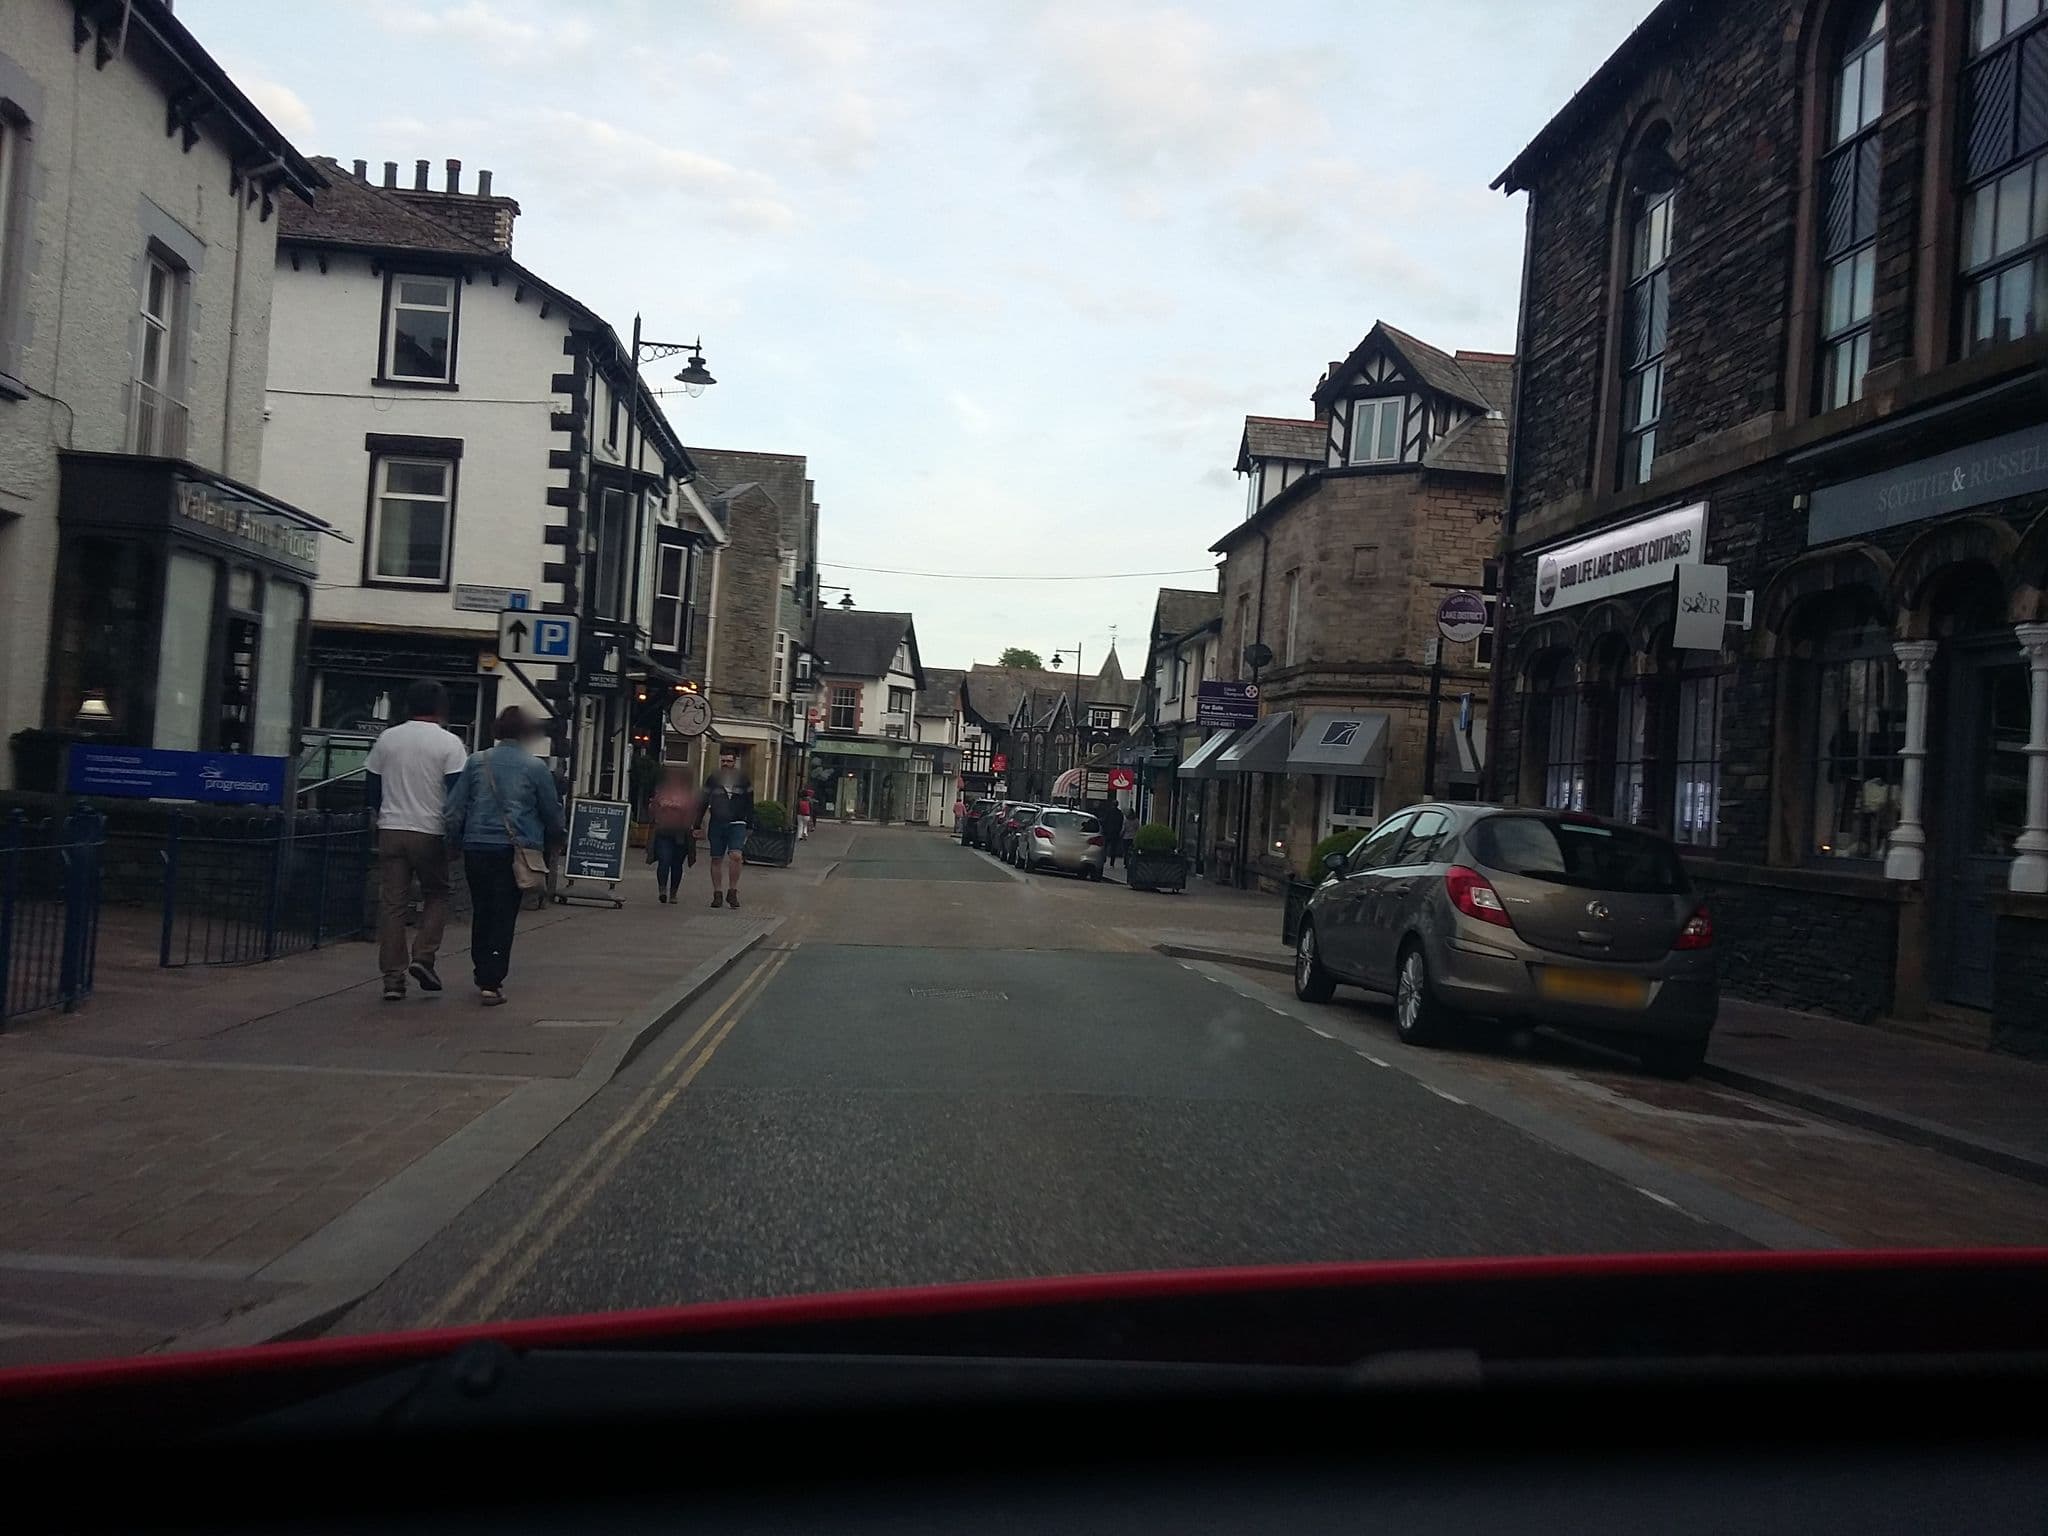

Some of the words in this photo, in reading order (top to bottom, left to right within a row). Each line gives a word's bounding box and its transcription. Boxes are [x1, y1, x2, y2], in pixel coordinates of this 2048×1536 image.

[1878, 471, 1949, 512] SCOTTIE
[1951, 466, 1966, 492] &
[1560, 564, 1578, 589] GOOD
[1578, 558, 1593, 584] LIFE
[1593, 552, 1612, 579] LAKE
[1613, 542, 1648, 574] DISTRICT
[1648, 529, 1692, 564] COTTAGES
[1441, 610, 1457, 619] LAKE
[540, 623, 567, 654] P
[205, 780, 270, 792] progression
